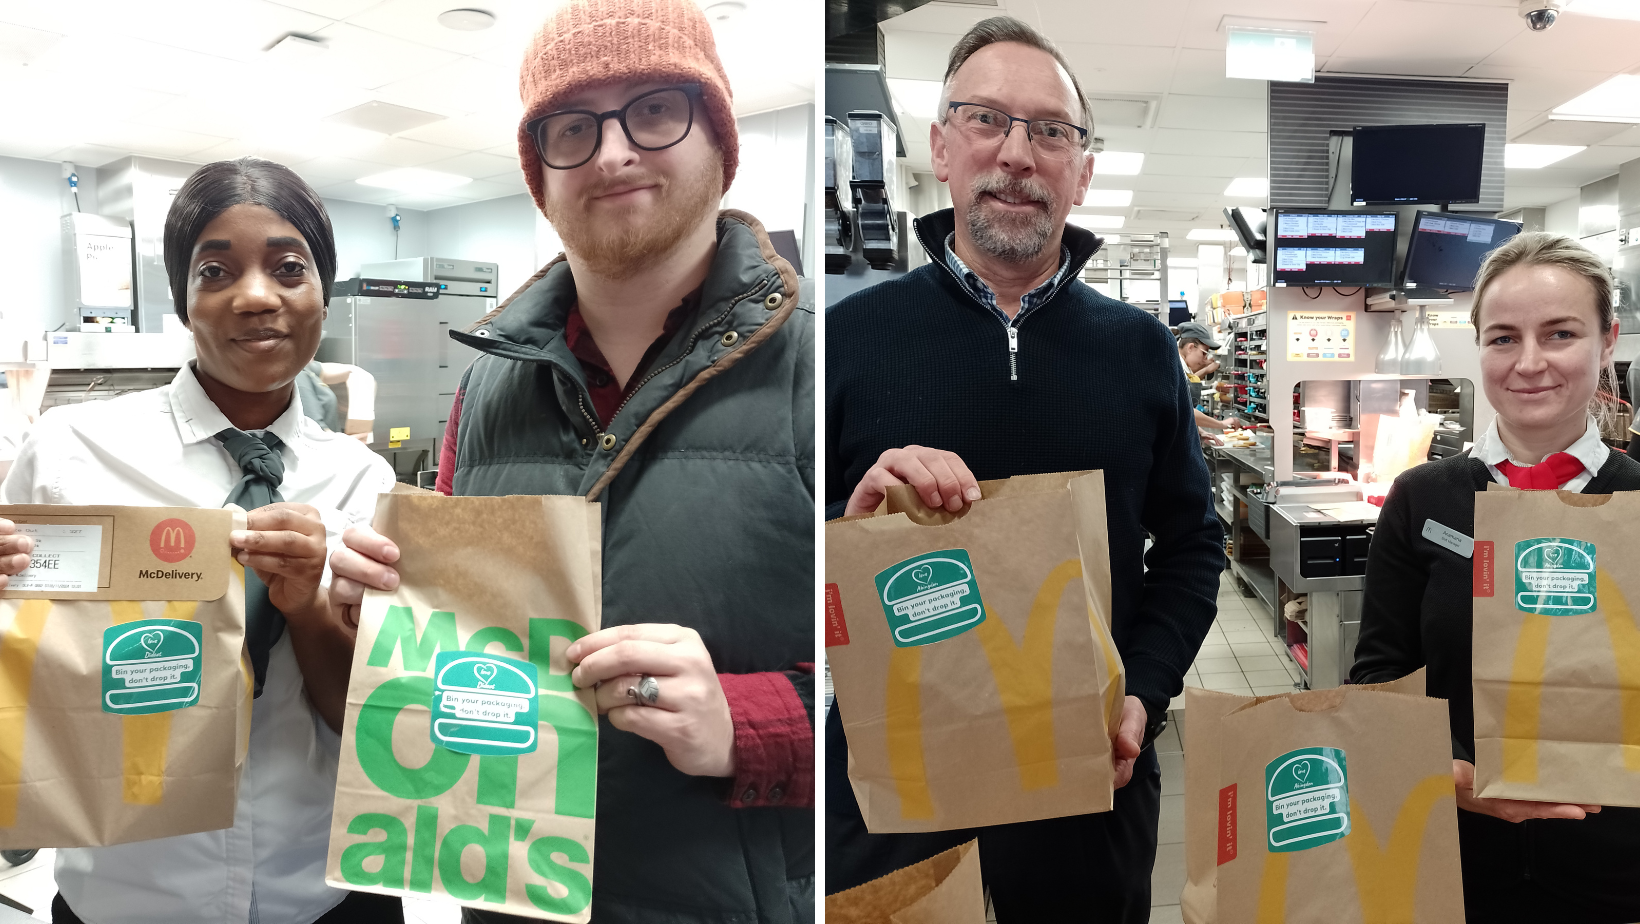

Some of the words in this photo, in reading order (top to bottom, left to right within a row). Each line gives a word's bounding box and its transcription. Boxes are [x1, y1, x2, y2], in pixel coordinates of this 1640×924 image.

[1551, 575, 1586, 583] packaging.
[897, 605, 909, 613] Bin
[910, 600, 927, 609] your
[928, 588, 967, 604] packaging.
[912, 607, 931, 618] don't
[932, 603, 949, 613] drop
[950, 600, 958, 608] it.
[130, 667, 147, 675] your
[149, 663, 190, 673] packaging.
[150, 675, 168, 683] drop
[461, 697, 479, 705] your
[481, 700, 526, 710] packaging.
[482, 710, 501, 719] drop
[1285, 800, 1300, 810] your
[1301, 793, 1338, 806] packaging.
[1285, 810, 1302, 819] don't
[1303, 806, 1319, 816] drop
[340, 804, 592, 915] ald's
